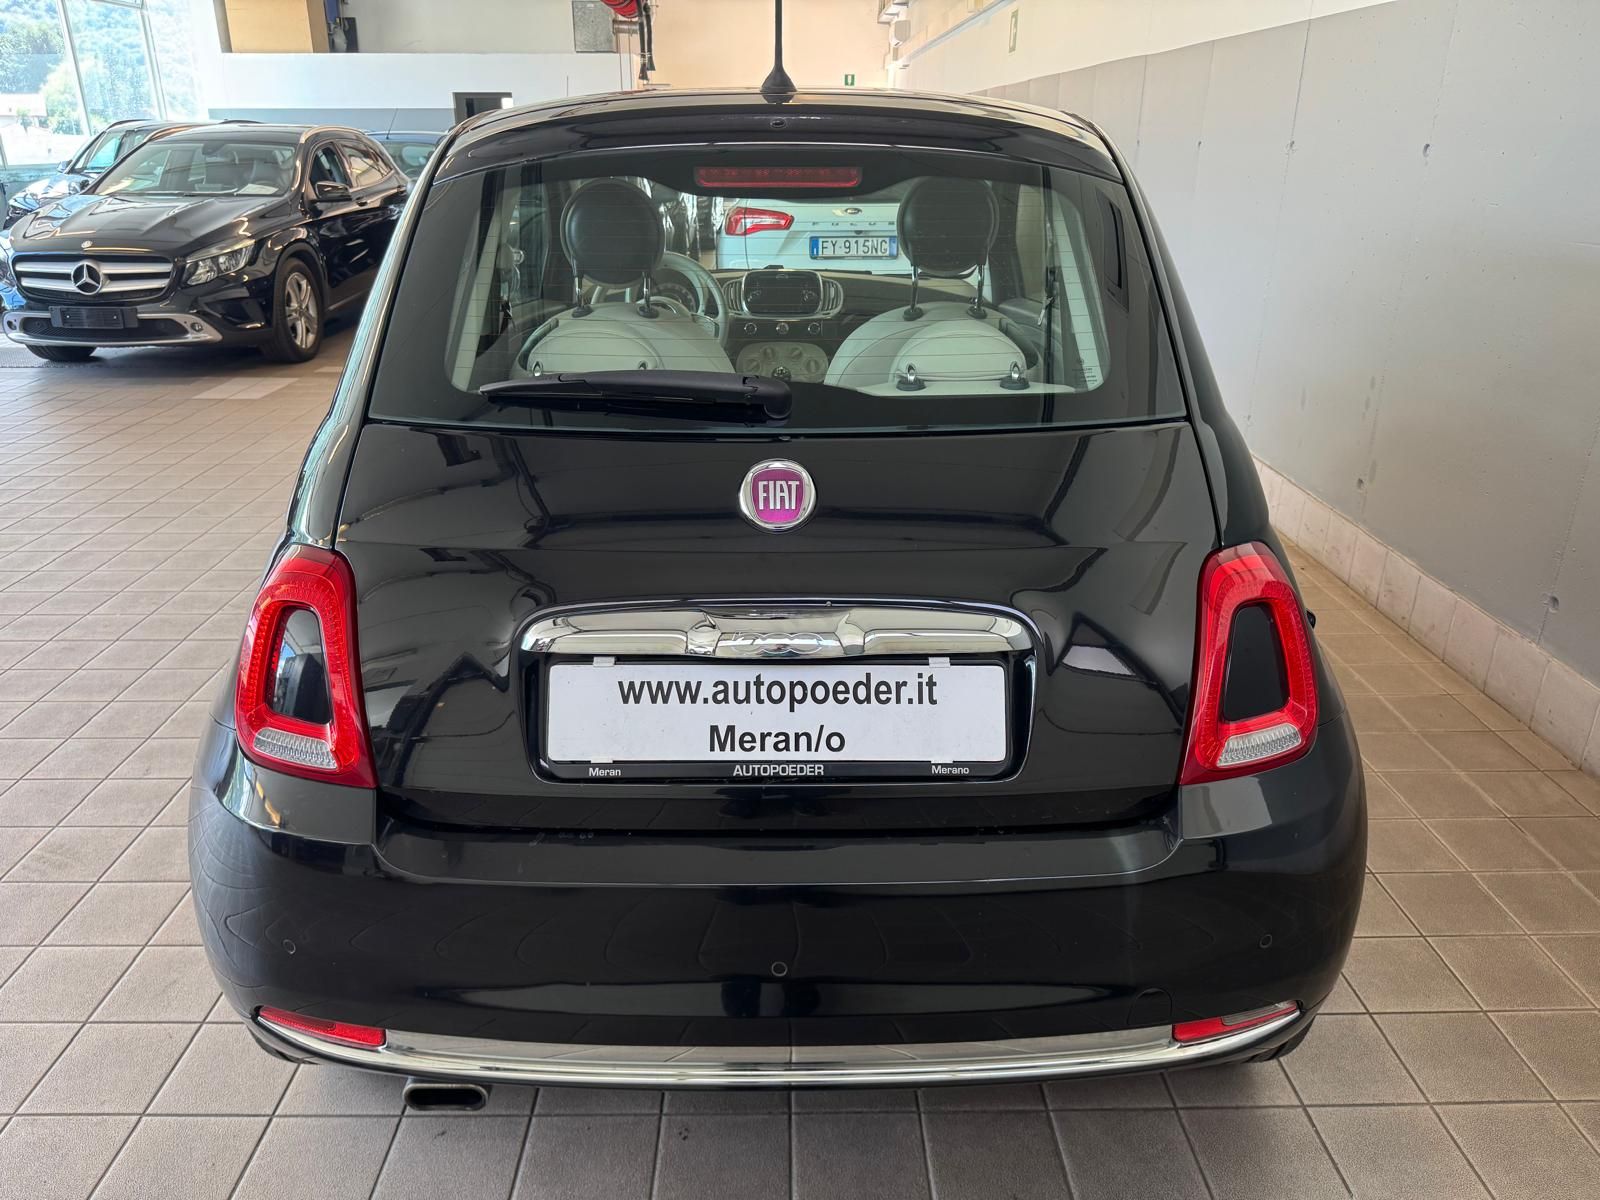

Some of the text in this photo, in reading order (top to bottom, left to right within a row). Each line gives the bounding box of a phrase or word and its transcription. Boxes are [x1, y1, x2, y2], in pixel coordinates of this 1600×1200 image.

[758, 480, 800, 510] FIAT
[618, 672, 938, 712] www.autopoeder.it
[709, 724, 846, 753] Meran/o
[588, 767, 622, 777] Meran
[733, 764, 825, 776] AUTOPOEDER
[931, 765, 970, 775] Merano
